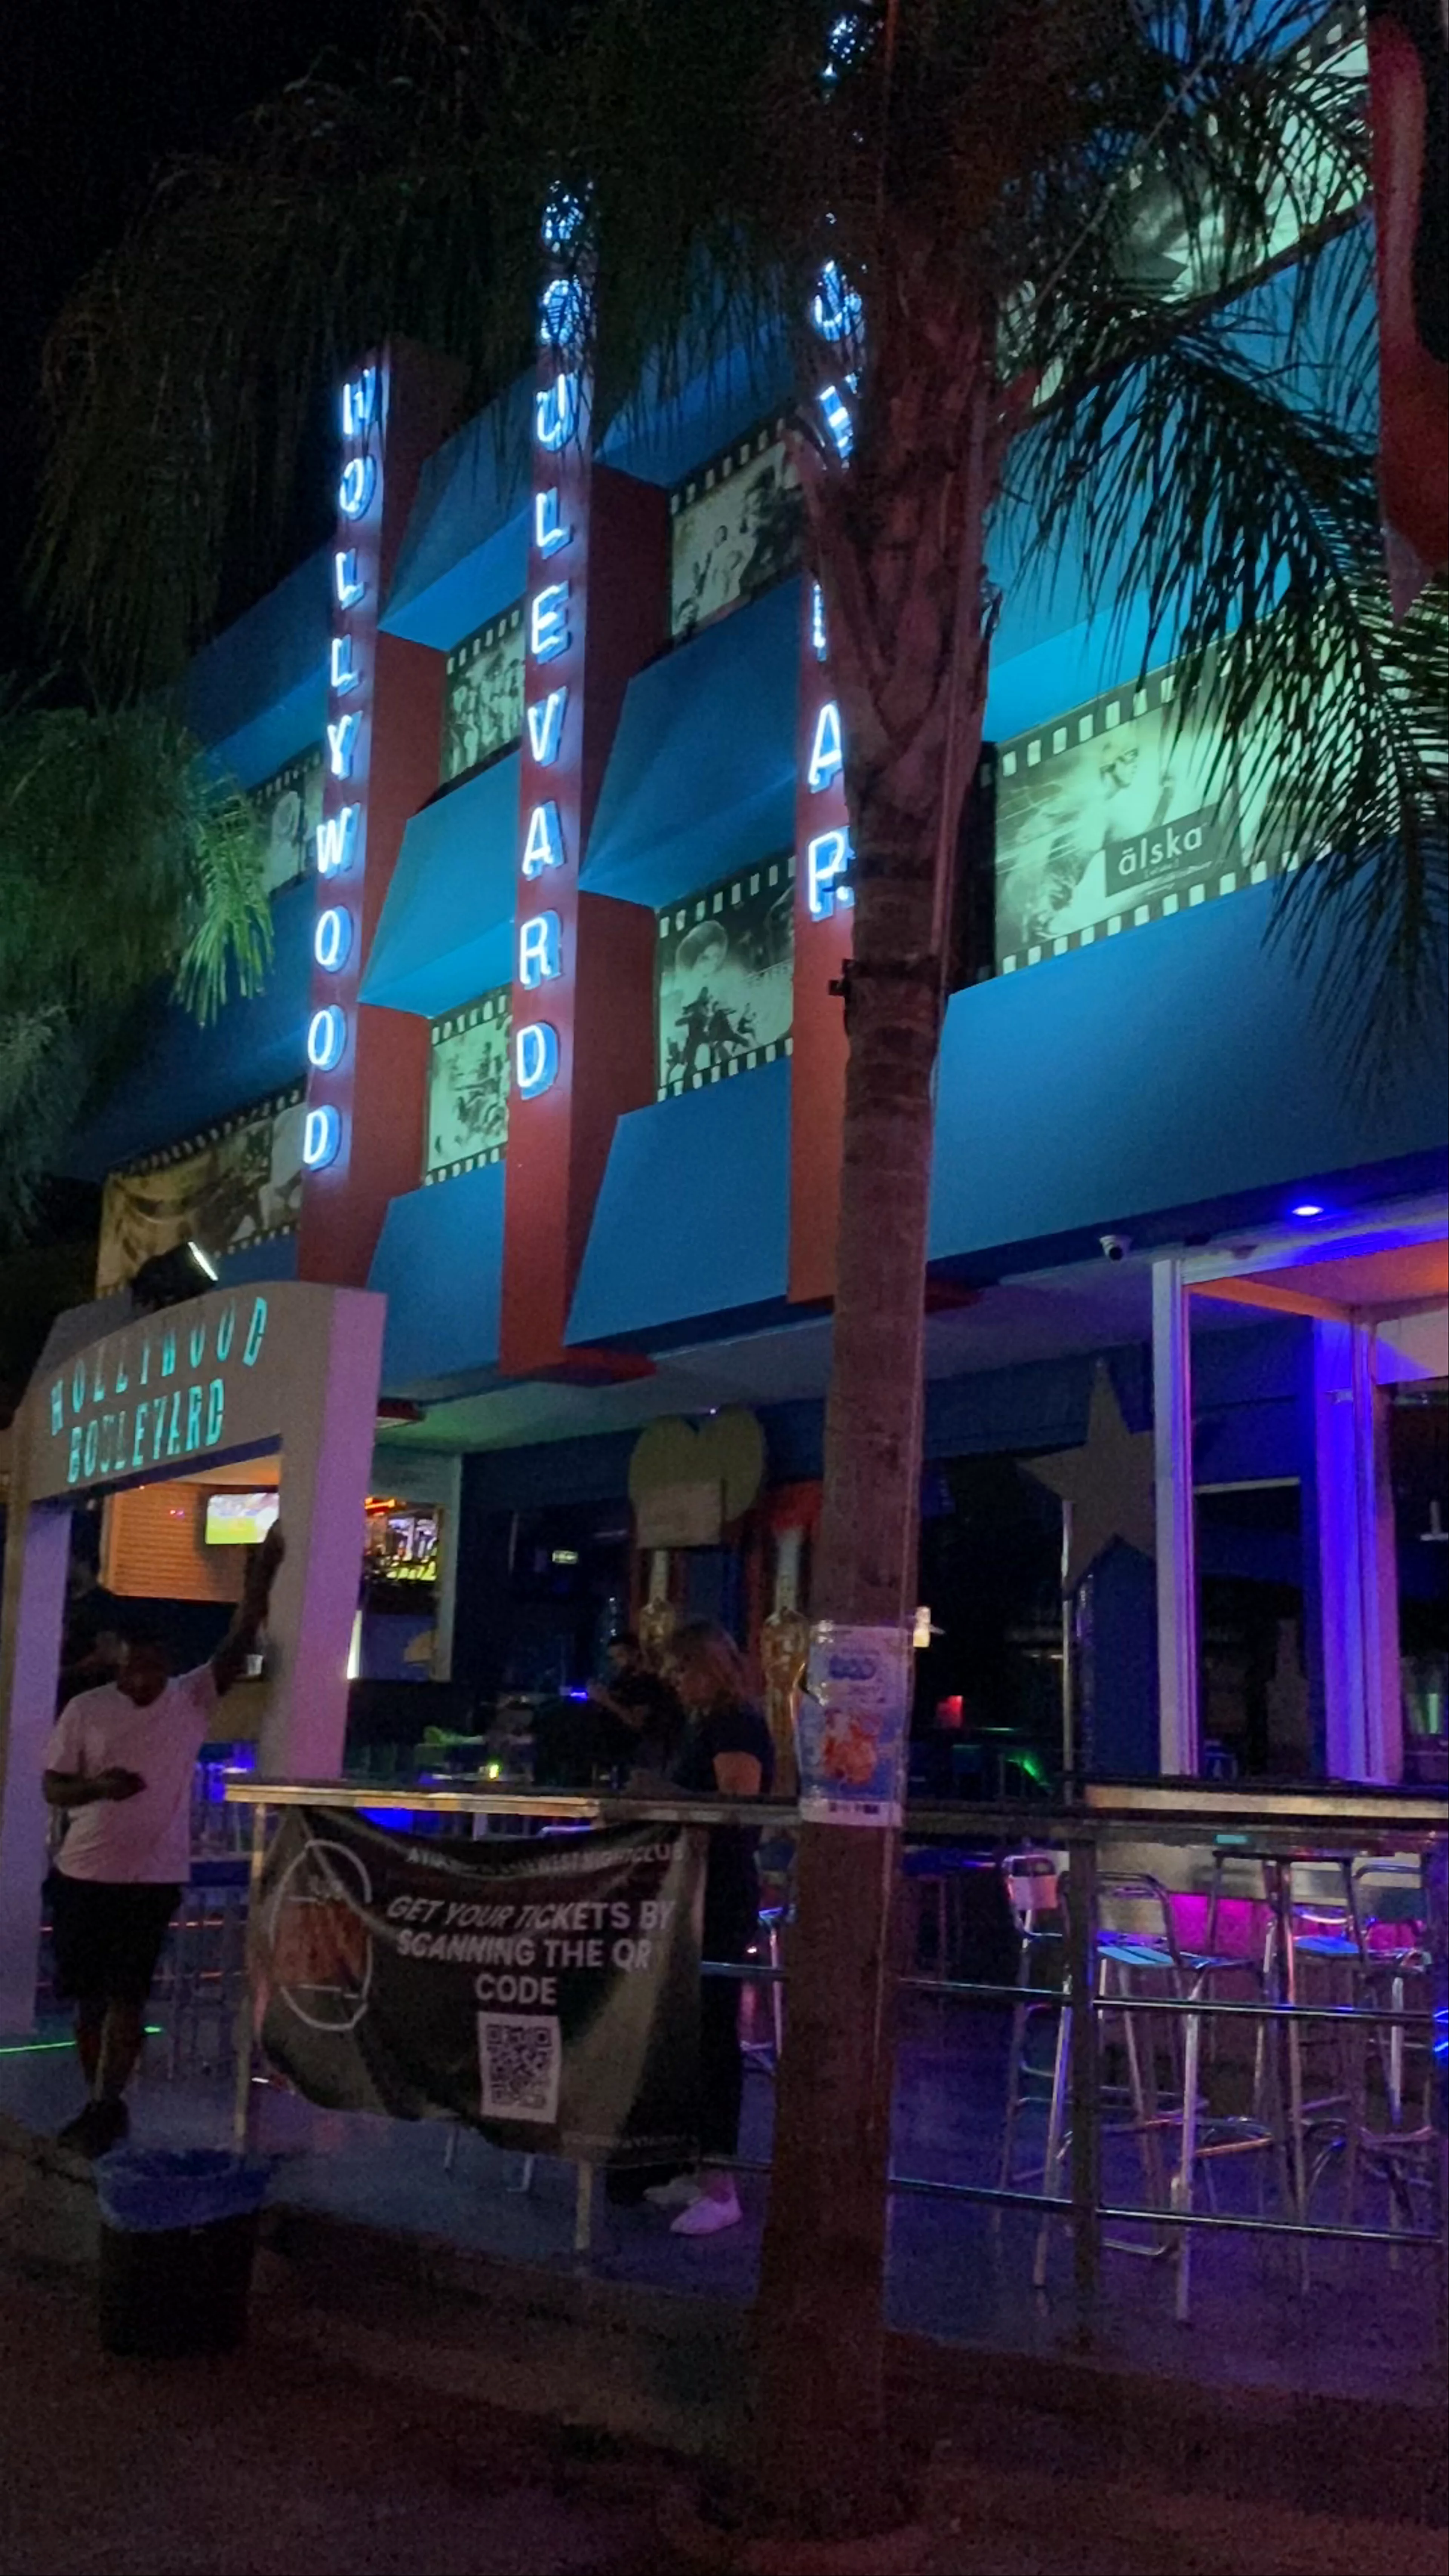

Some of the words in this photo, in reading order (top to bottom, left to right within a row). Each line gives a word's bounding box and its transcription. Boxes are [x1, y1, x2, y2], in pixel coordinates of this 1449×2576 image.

[303, 365, 377, 1172] HOLLYWOOD
[67, 1378, 224, 1483] BOULEVARD
[386, 1896, 445, 1923] GET
[445, 1902, 515, 1929] YOUR
[514, 1901, 632, 1930] TICKETS
[640, 1899, 676, 1930] BY
[397, 1929, 536, 1966] SCANNING
[543, 1939, 603, 1968] THE
[612, 1938, 652, 1973] QR
[476, 1973, 558, 2007] CODE
